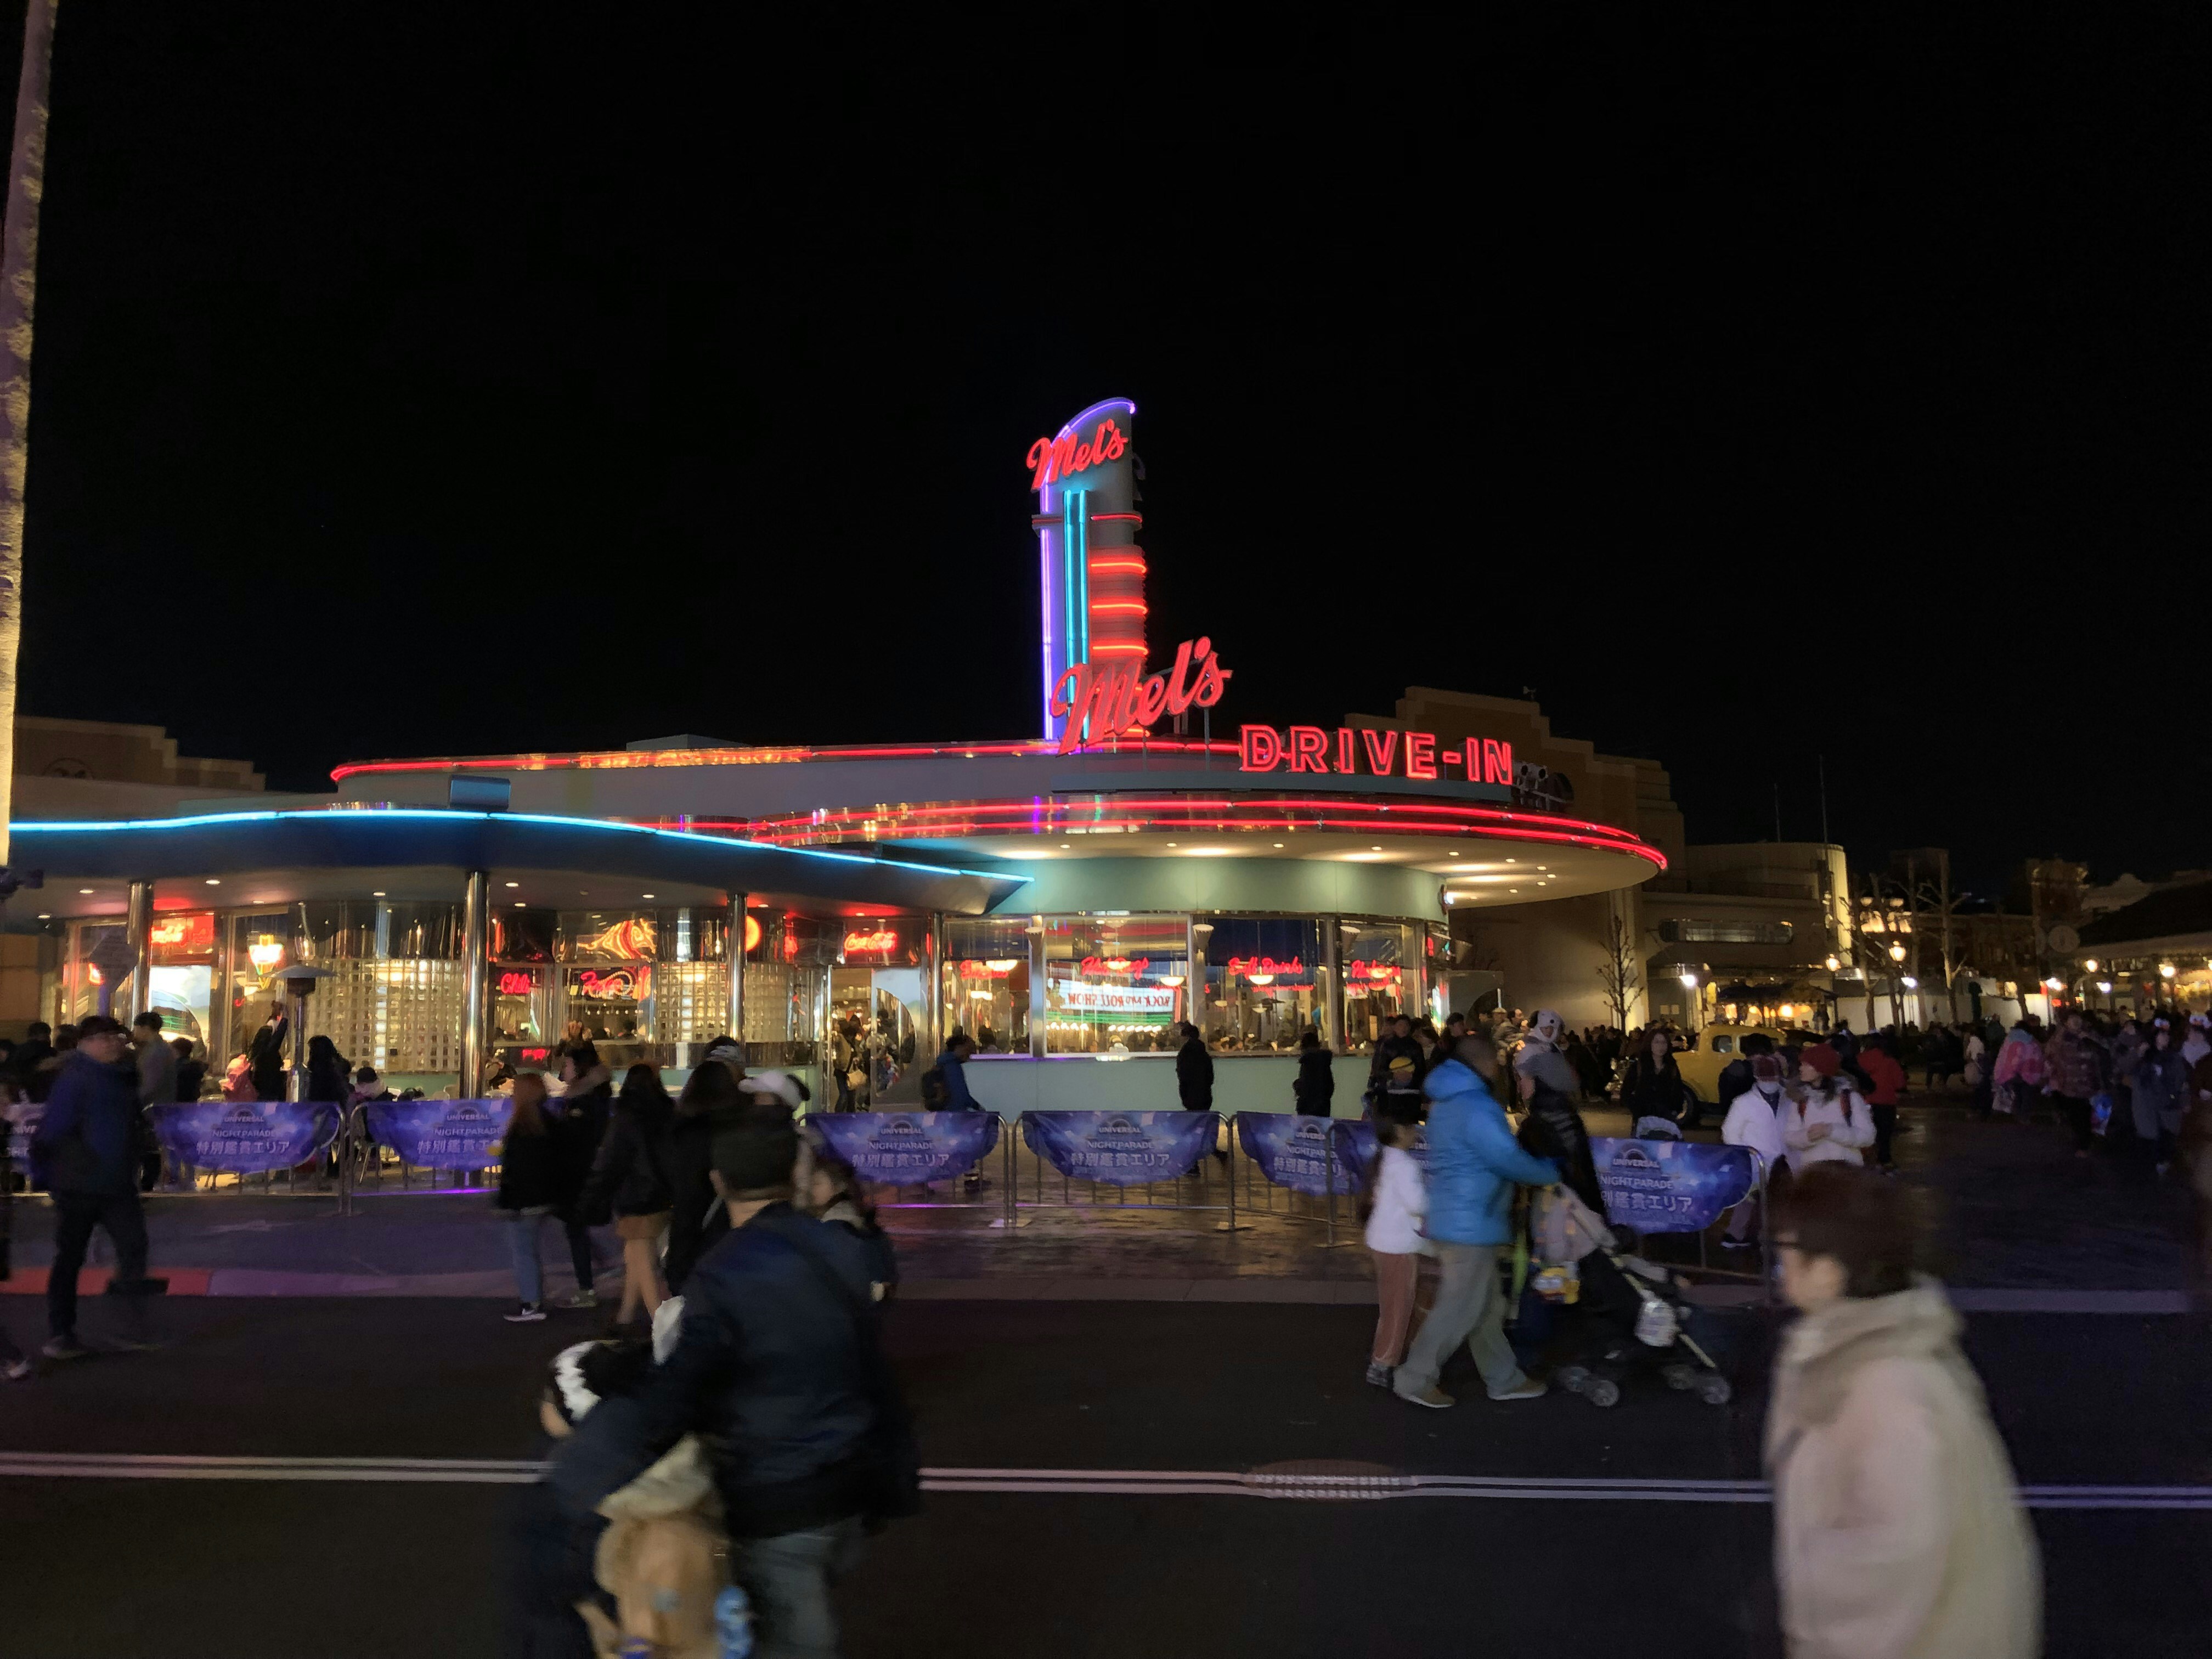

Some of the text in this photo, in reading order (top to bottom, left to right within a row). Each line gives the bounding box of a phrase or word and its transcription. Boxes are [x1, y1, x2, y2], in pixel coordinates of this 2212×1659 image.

[1026, 419, 1128, 490] Mel's
[1049, 636, 1232, 757] Mel's
[1240, 724, 1513, 785] DRIVE-IN
[1612, 1158, 1660, 1168] UNIVERSAL
[1601, 1190, 1692, 1213] 別鑑賞エリア
